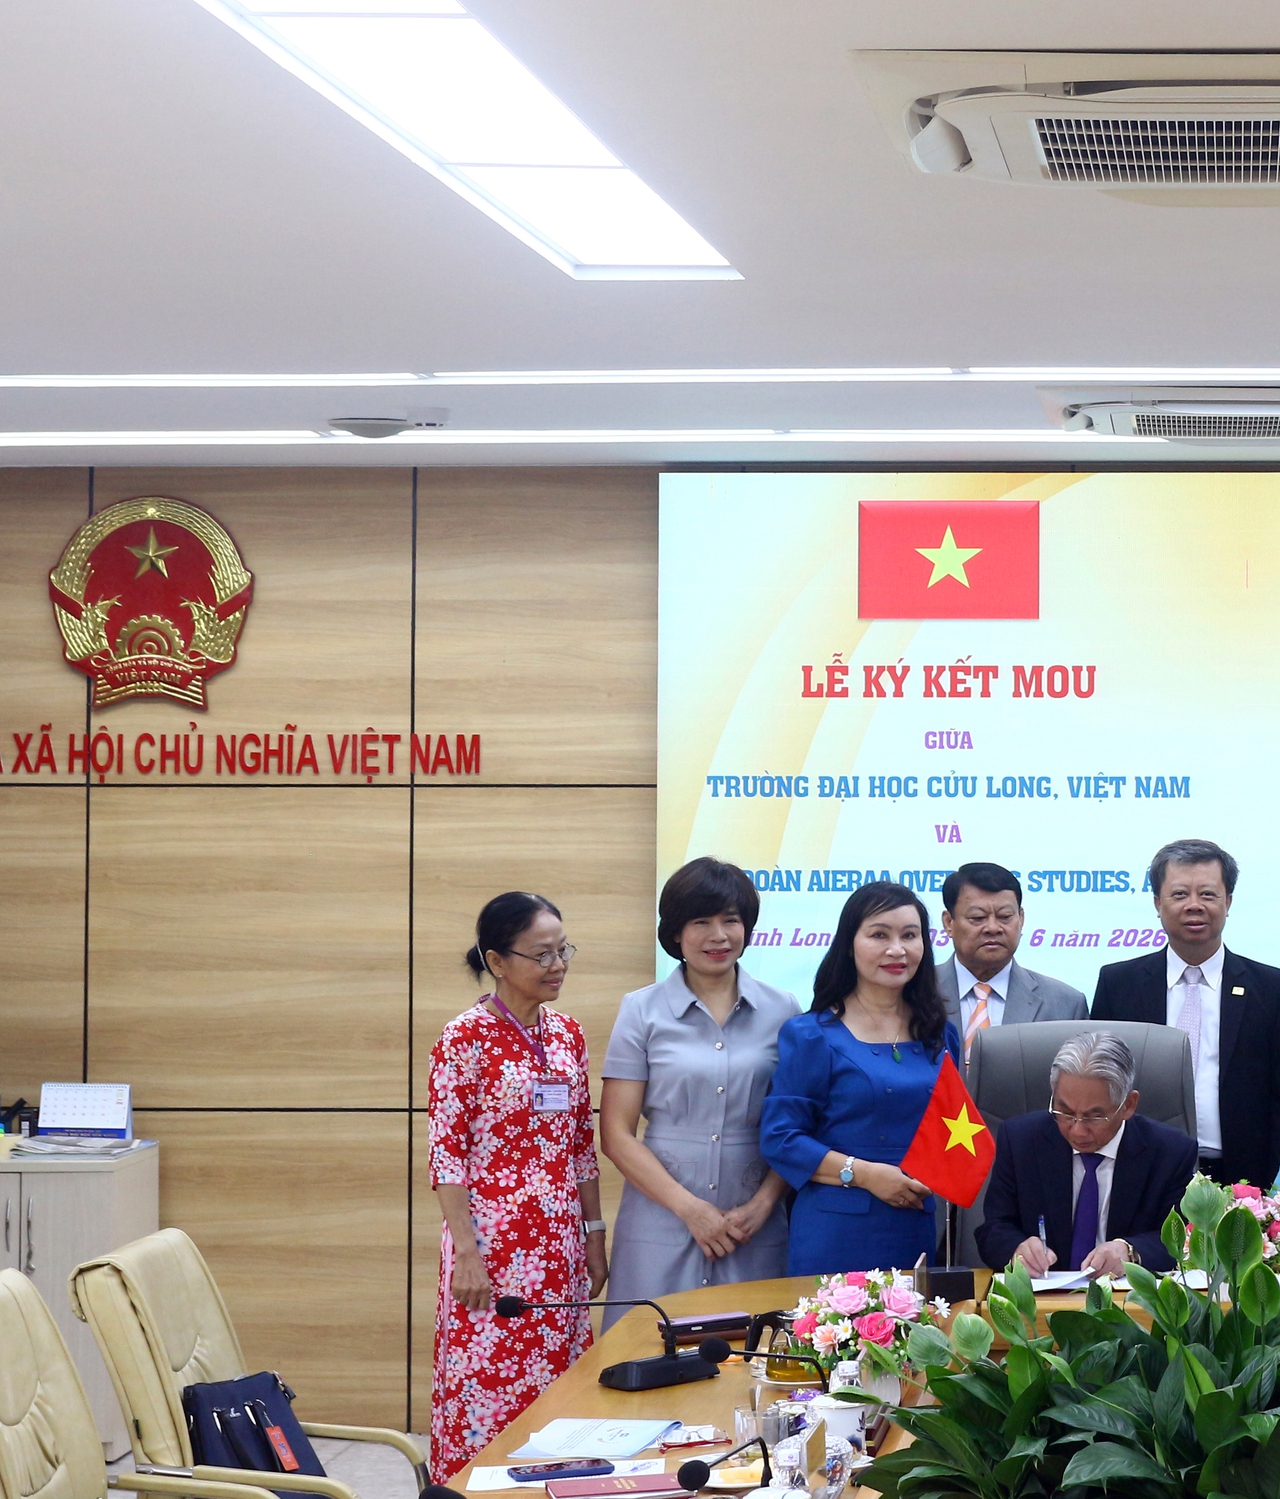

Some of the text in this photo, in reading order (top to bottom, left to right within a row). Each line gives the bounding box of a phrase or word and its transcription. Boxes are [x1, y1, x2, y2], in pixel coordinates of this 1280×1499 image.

[801, 652, 1096, 699] LỄ KÝ KẾT MOU
[924, 728, 974, 750] GIỮA
[11, 722, 482, 784] XÃ HỘI CHỦ NGHĨA VIỆT NAM
[706, 768, 1191, 803] TRƯỜNG ĐẠI HỌC CỬU LONG, VIỆT NAM
[934, 822, 962, 843] VÀ
[1027, 870, 1136, 894] STUDIES,
[789, 928, 833, 947] Lon
[1029, 928, 1047, 948] 6
[1051, 929, 1101, 948] năm
[1107, 928, 1173, 948] 2026
